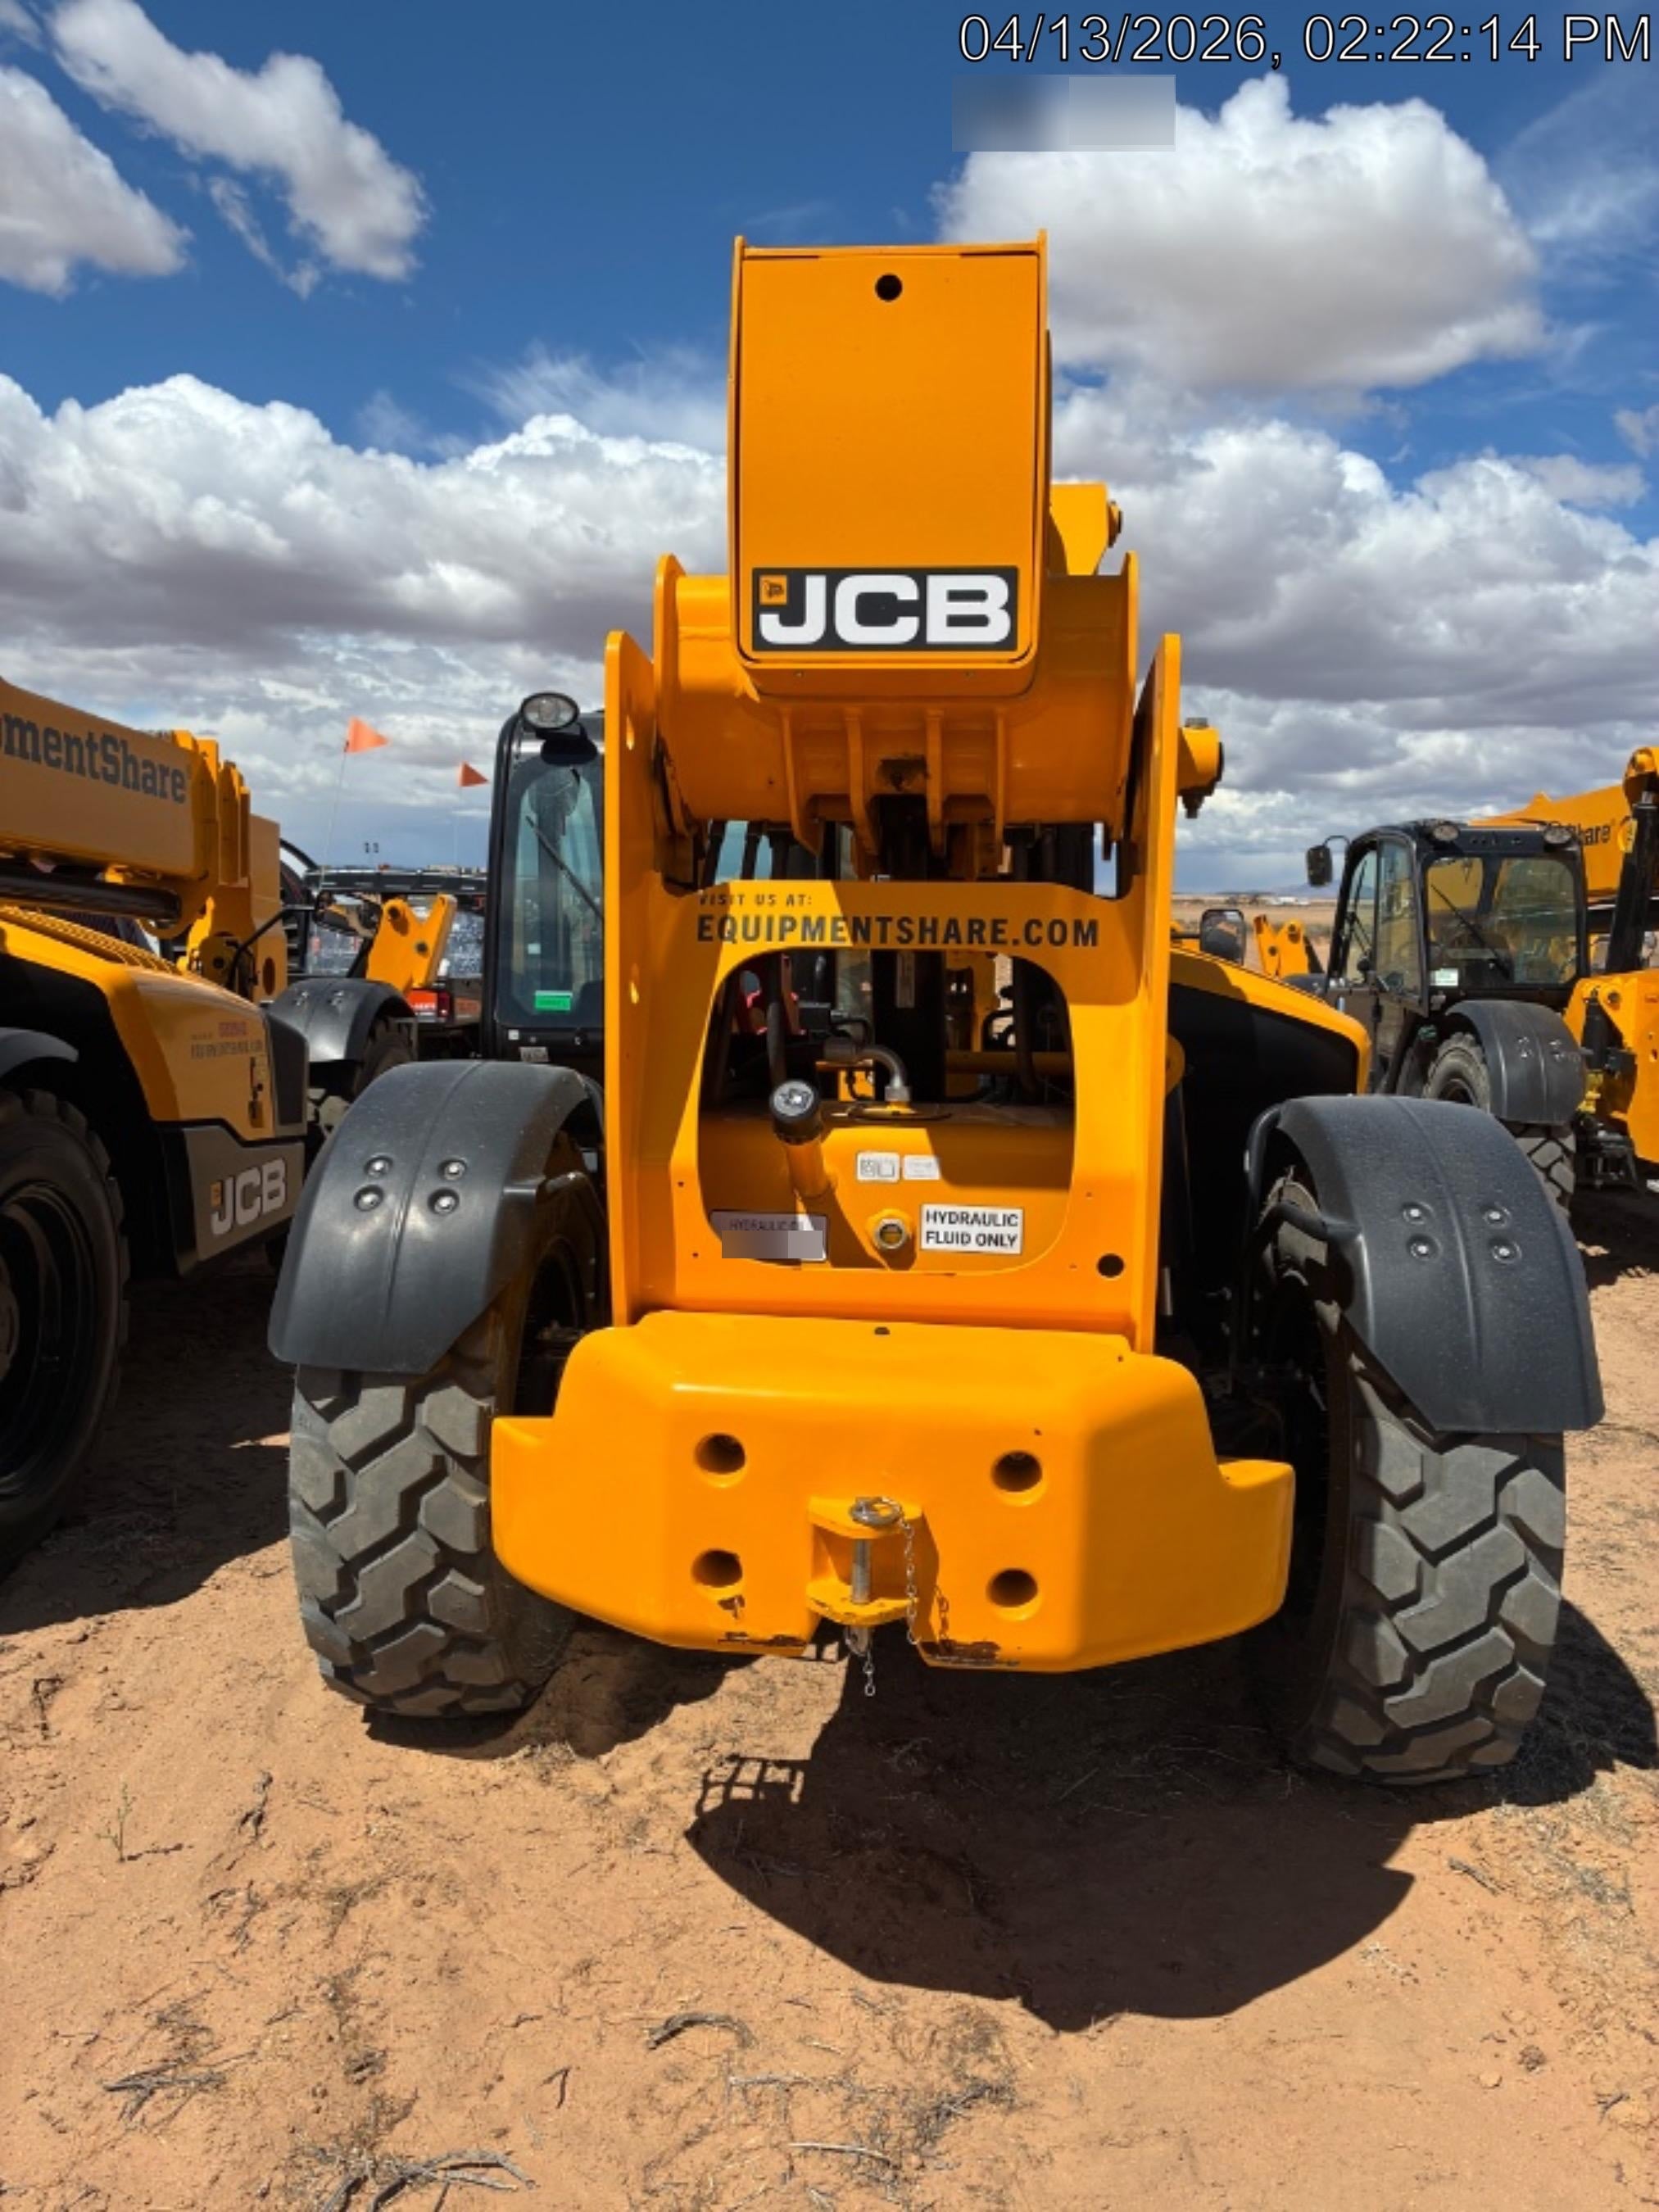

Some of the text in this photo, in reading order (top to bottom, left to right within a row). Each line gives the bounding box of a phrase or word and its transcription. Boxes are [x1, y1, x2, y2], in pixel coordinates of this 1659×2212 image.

[759, 573, 1012, 646] JCB
[0, 712, 186, 805] mentShare
[698, 893, 813, 907] VISIT US AT:
[696, 913, 1099, 947] EQUIPMENTSHARE.COM
[211, 1157, 286, 1235] JCB
[926, 1208, 1018, 1227] HYDRAULIC
[926, 1230, 1017, 1247] FLUID ONLY
